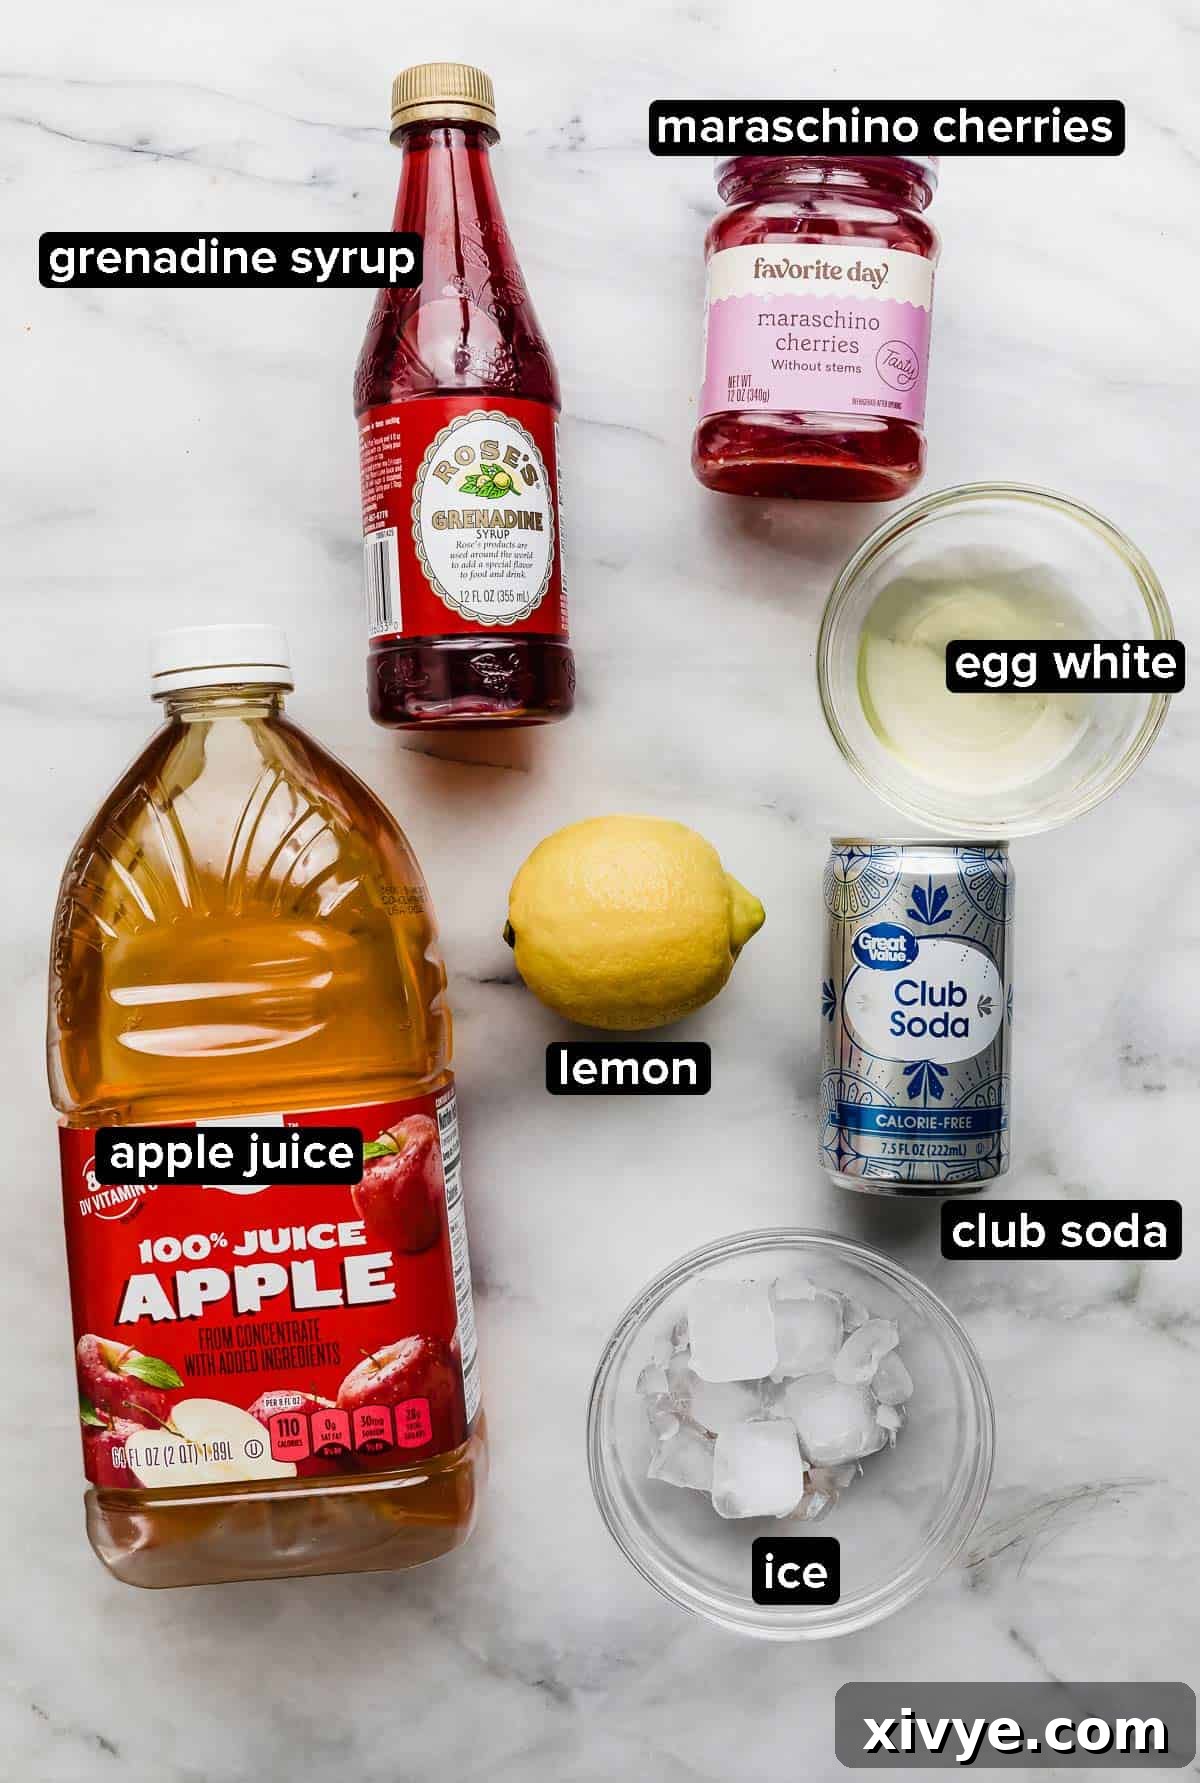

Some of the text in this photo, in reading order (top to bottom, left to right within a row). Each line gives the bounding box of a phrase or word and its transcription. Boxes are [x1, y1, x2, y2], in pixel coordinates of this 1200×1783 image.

[753, 257, 889, 289] favorite day
[757, 310, 880, 331] maraschino
[775, 333, 860, 354] cherries
[771, 359, 862, 374] Without stems
[883, 349, 918, 385] Tasty
[728, 374, 752, 388] NET WT
[736, 389, 745, 402] OZ
[747, 388, 769, 402] (340g)
[432, 439, 539, 487] ROSE'S
[431, 509, 543, 531] GRENADINE
[476, 529, 510, 539] SYRUP
[450, 551, 468, 559] used
[514, 551, 533, 559] world
[456, 541, 480, 549] Rose's
[483, 541, 514, 550] products
[469, 571, 487, 580] food
[485, 561, 512, 570] special
[460, 589, 530, 603] 12 FL OZ (355 mL)
[858, 932, 906, 962] Great Value
[894, 979, 967, 1008] Club
[889, 1010, 969, 1038] Soda
[876, 1114, 972, 1128] CALORIE-FREE
[881, 1142, 896, 1153] 7.5
[899, 1142, 911, 1155] FL
[912, 1143, 925, 1155] OZ
[927, 1143, 967, 1156] (222mL)
[79, 1185, 147, 1217] DV VITAMIN
[139, 1220, 367, 1264] 100% JUICE
[118, 1251, 397, 1324] APPLE
[198, 1318, 321, 1351] FROM CONCENTRATE
[184, 1343, 341, 1377] WITH ADDED INGREDIENTS
[265, 1397, 300, 1407] PER 8 FL OZ
[277, 1418, 300, 1438] 110
[324, 1418, 336, 1431] 0g
[360, 1415, 384, 1427] 30mg
[277, 1439, 303, 1448] CALORIES
[112, 1441, 233, 1468] 64 FL OZ (2 QT) 1.89L
